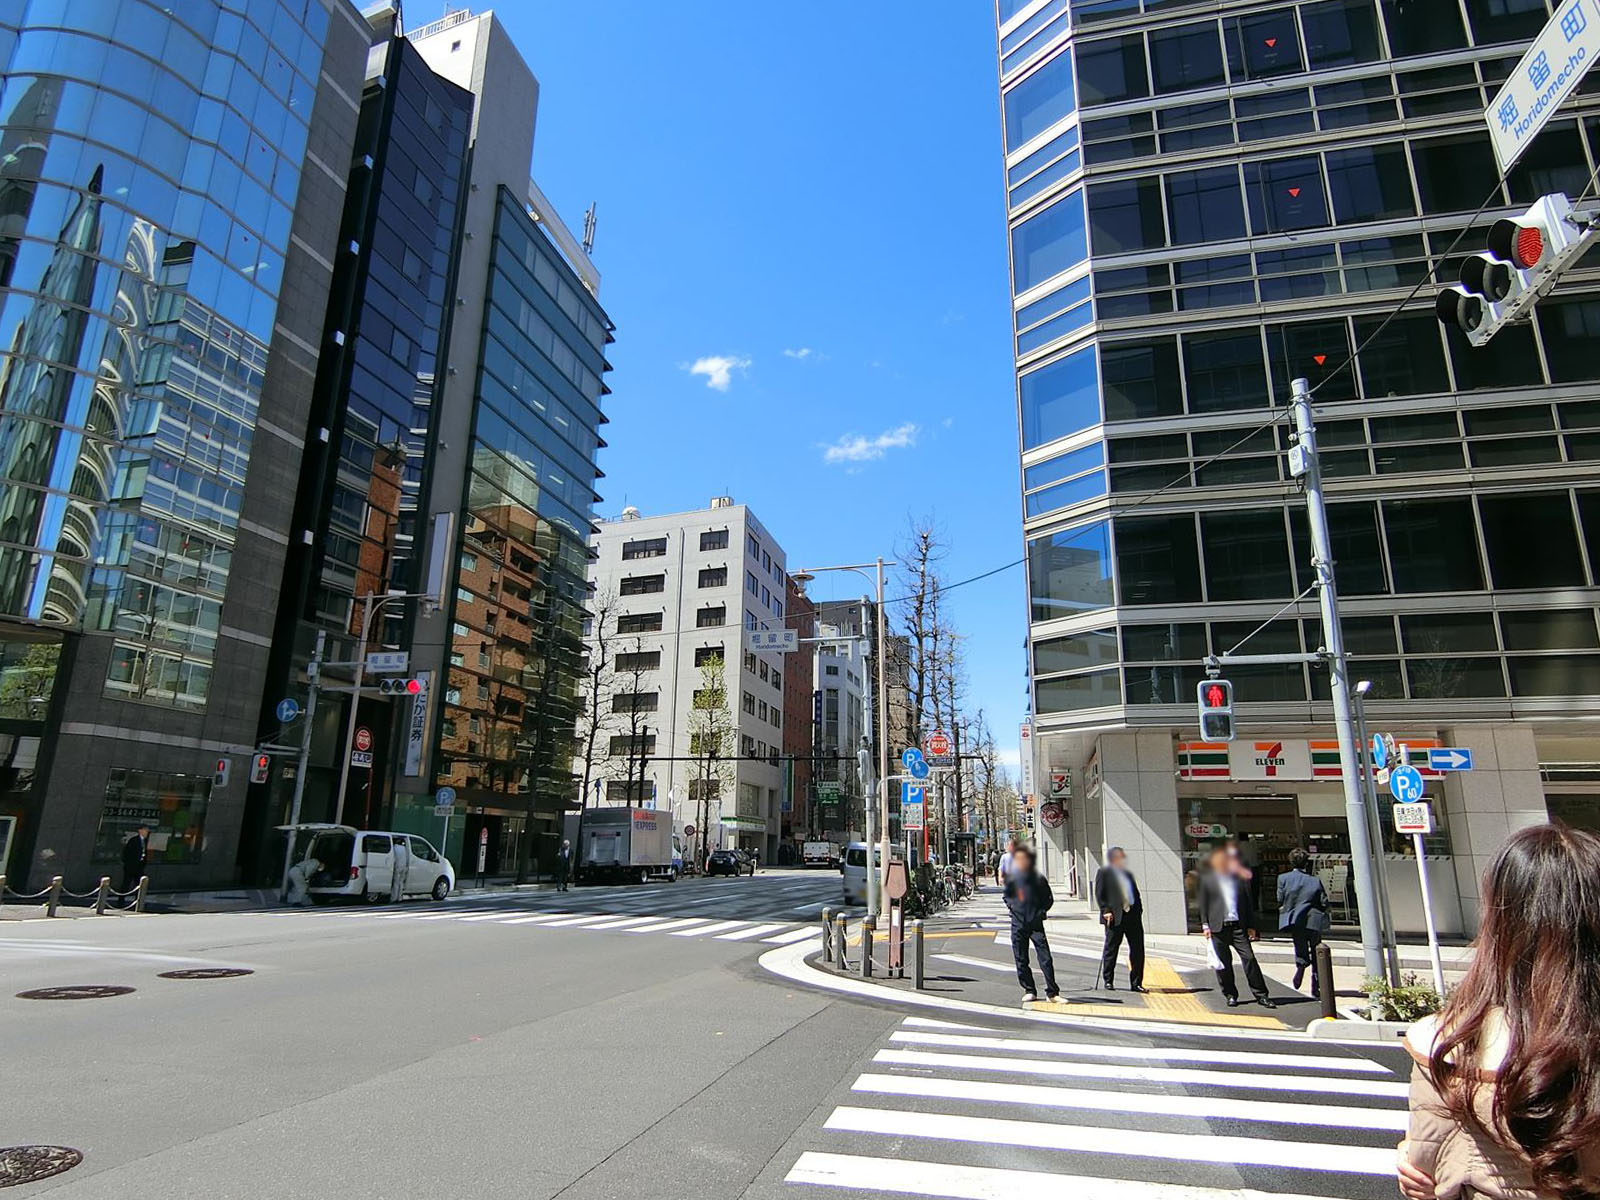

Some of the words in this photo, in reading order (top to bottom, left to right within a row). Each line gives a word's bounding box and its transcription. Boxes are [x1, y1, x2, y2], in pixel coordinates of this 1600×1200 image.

[1498, 1, 1587, 133] 堀留町
[1513, 46, 1586, 140] Horidomecho
[411, 683, 427, 742] たか証券
[906, 753, 916, 768] P
[907, 783, 920, 802] P
[1396, 775, 1410, 800] P
[1190, 825, 1209, 834] たばこ
